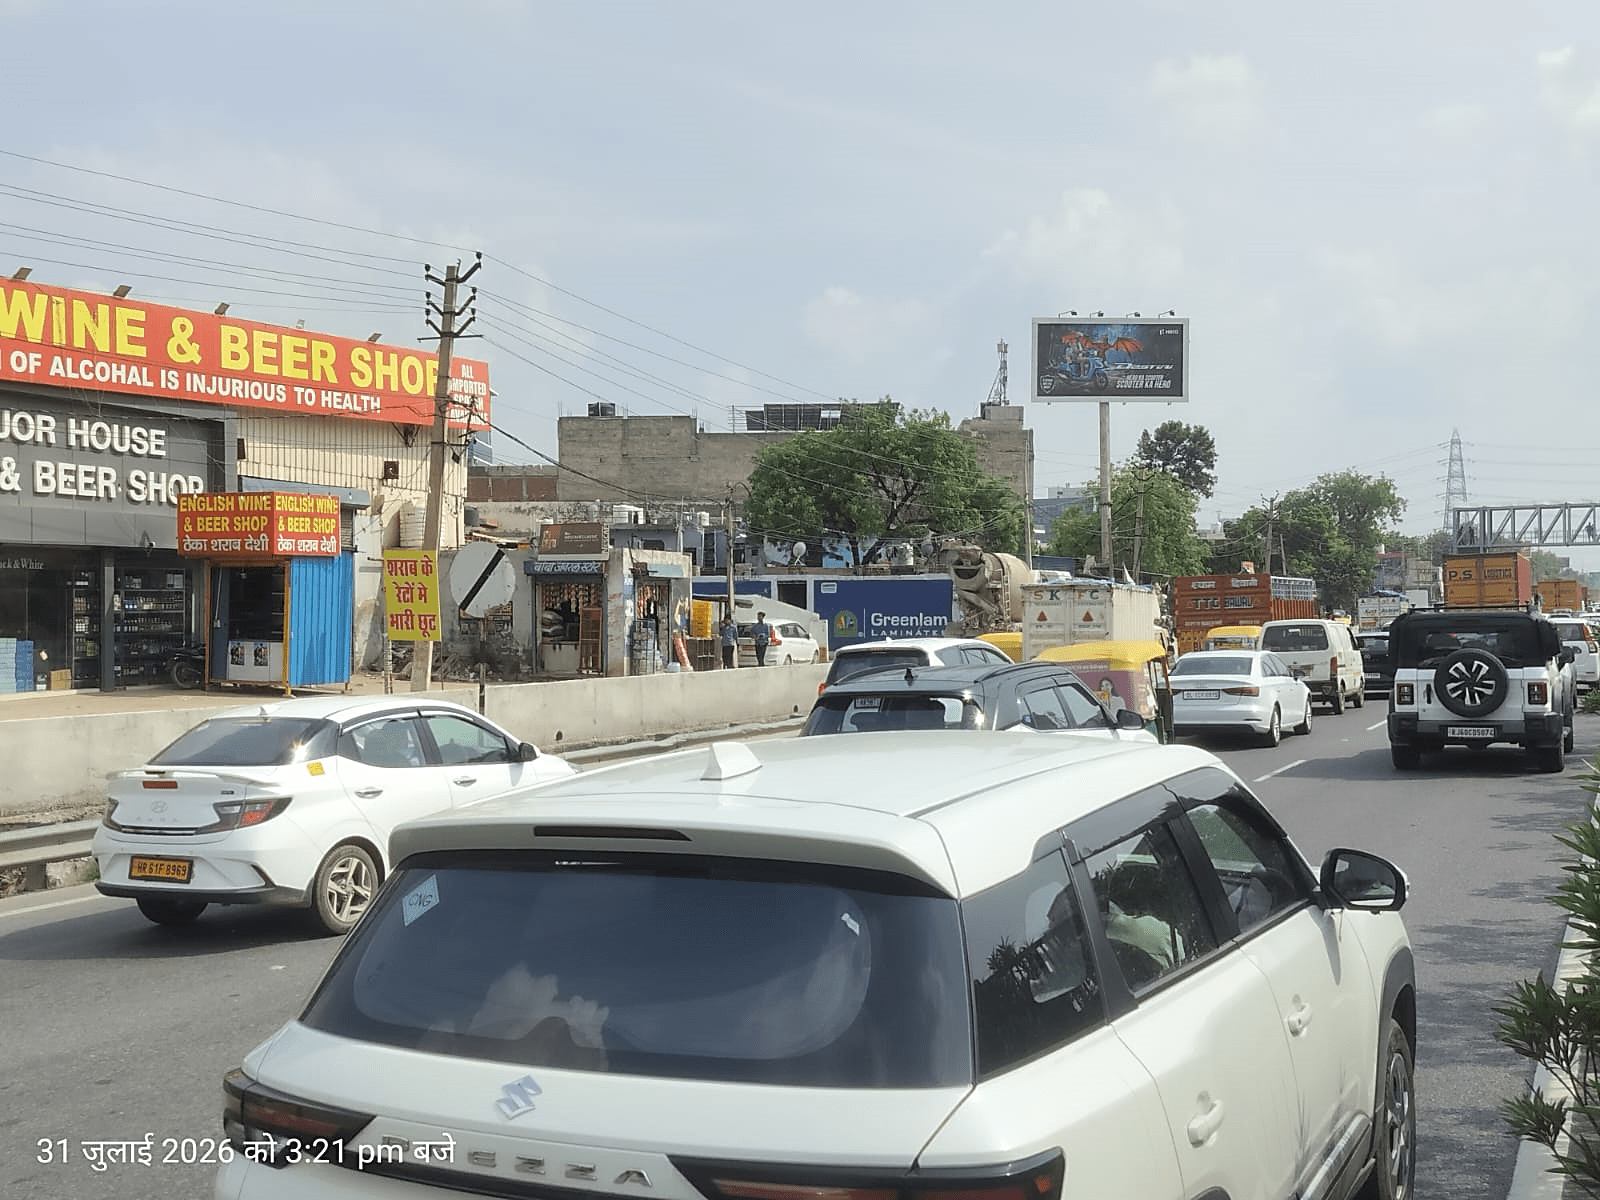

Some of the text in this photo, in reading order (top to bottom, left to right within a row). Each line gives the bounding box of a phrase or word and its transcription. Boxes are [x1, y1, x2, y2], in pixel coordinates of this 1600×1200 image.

[0, 287, 146, 357] WINE
[166, 316, 201, 364] &
[220, 324, 338, 383] BEER
[461, 363, 474, 379] ALL
[10, 350, 381, 414] OF ALCOHAL IS INJURIOUS TO HEALTH
[1116, 379, 1144, 389] SCOOTER
[67, 418, 167, 457] HOUSE
[0, 456, 205, 505] & BEER SHOP
[179, 495, 272, 512] ENGLISH WINE
[275, 495, 338, 514] ENGLISH WINE
[183, 516, 268, 532] & BEER SHOP
[277, 516, 336, 534] & BEER SHOP
[182, 533, 269, 551] ठेका शराब देशी
[277, 534, 337, 552] ठेका शराब देशी
[386, 554, 433, 576] शराब के
[390, 608, 436, 638] भारी छूट
[870, 612, 948, 627] Greenlam
[137, 861, 147, 873] HR
